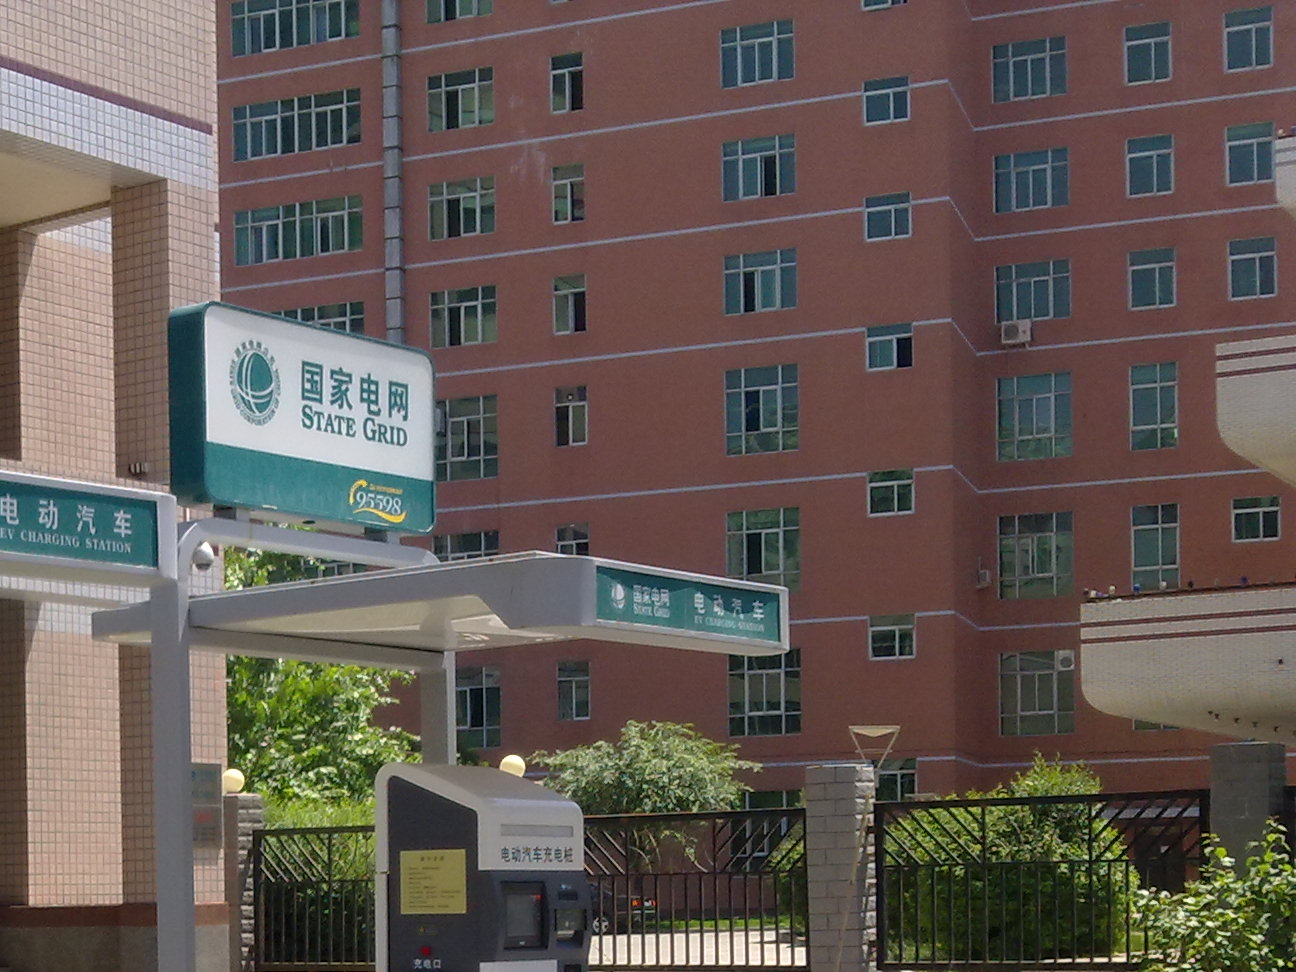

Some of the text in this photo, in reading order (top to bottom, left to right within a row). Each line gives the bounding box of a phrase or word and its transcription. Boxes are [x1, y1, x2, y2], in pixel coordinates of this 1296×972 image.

[300, 360, 409, 422] 国家电网
[301, 404, 408, 447] STATE GRID
[0, 493, 133, 538] 电动汽车
[356, 491, 402, 515] 95598
[0, 527, 132, 553] EV CHARGING STATION
[501, 846, 573, 863] 电动汽车充电桩
